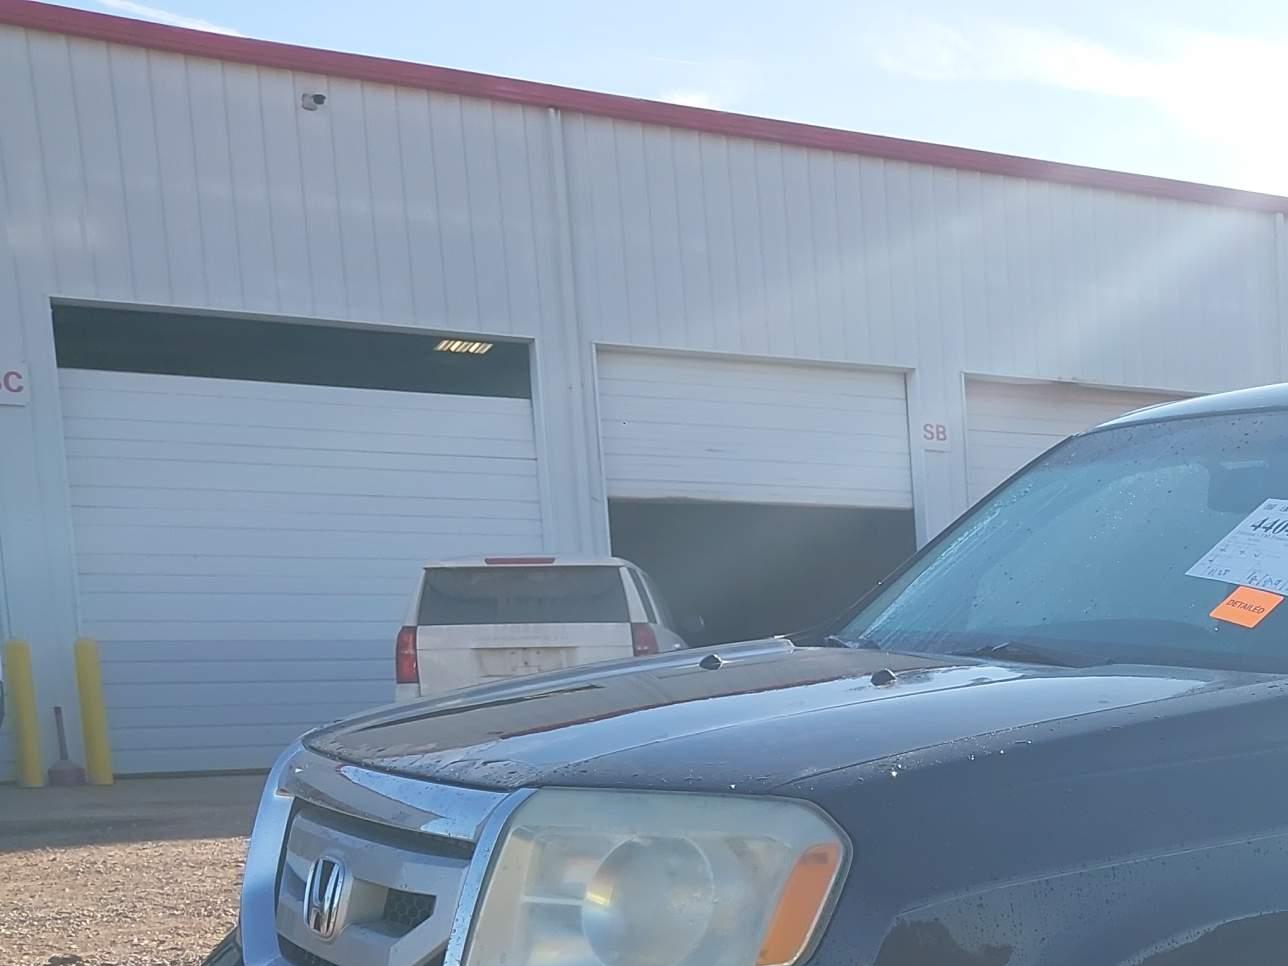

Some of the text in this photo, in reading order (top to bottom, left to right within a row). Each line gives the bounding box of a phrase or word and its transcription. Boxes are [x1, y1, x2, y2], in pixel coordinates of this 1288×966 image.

[0, 371, 24, 393] C
[923, 423, 947, 441] SB
[1226, 599, 1265, 614] DETAILED
